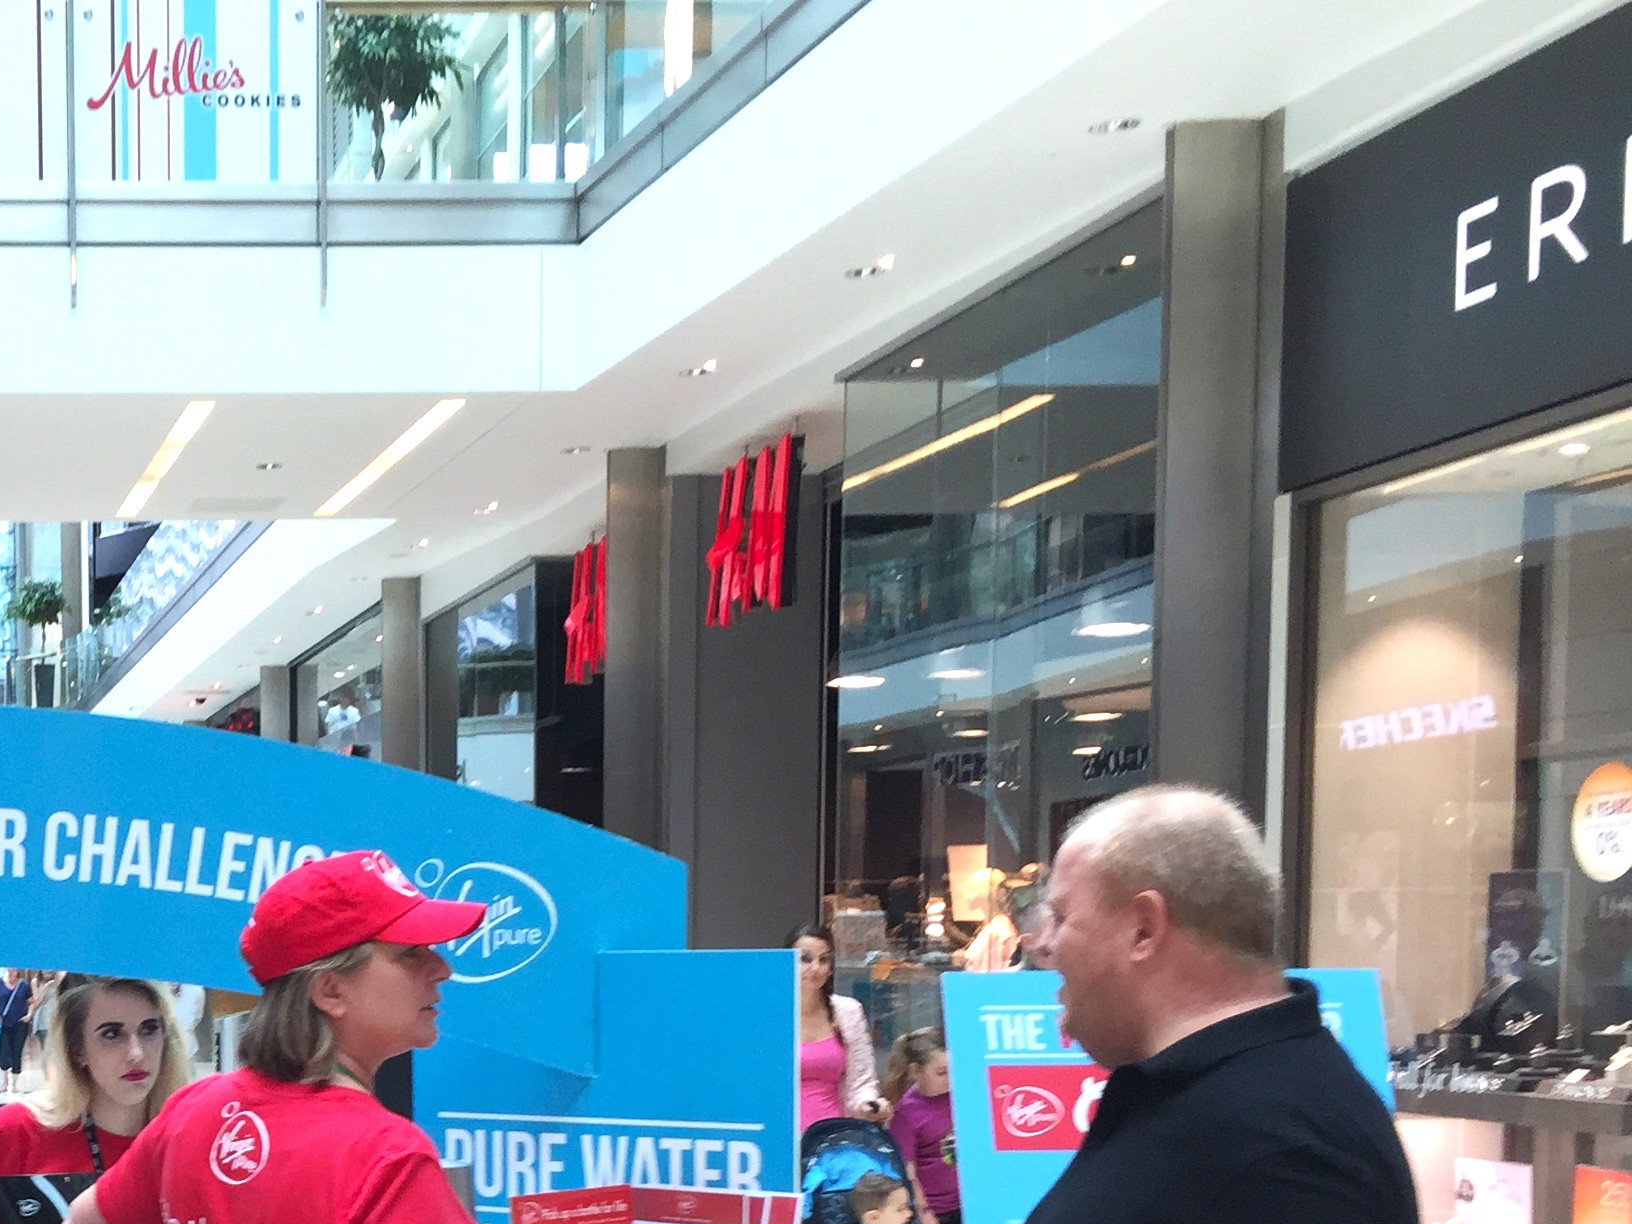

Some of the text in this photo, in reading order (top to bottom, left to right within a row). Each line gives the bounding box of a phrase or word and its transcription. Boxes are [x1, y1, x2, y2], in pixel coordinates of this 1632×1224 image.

[87, 36, 245, 109] Millie's
[202, 94, 301, 108] COOKIES
[1455, 133, 1632, 313] ER
[42, 810, 342, 904] CHALLEN
[493, 926, 543, 952] pure
[979, 1013, 1047, 1051] THE
[445, 1128, 763, 1198] PURE WATER
